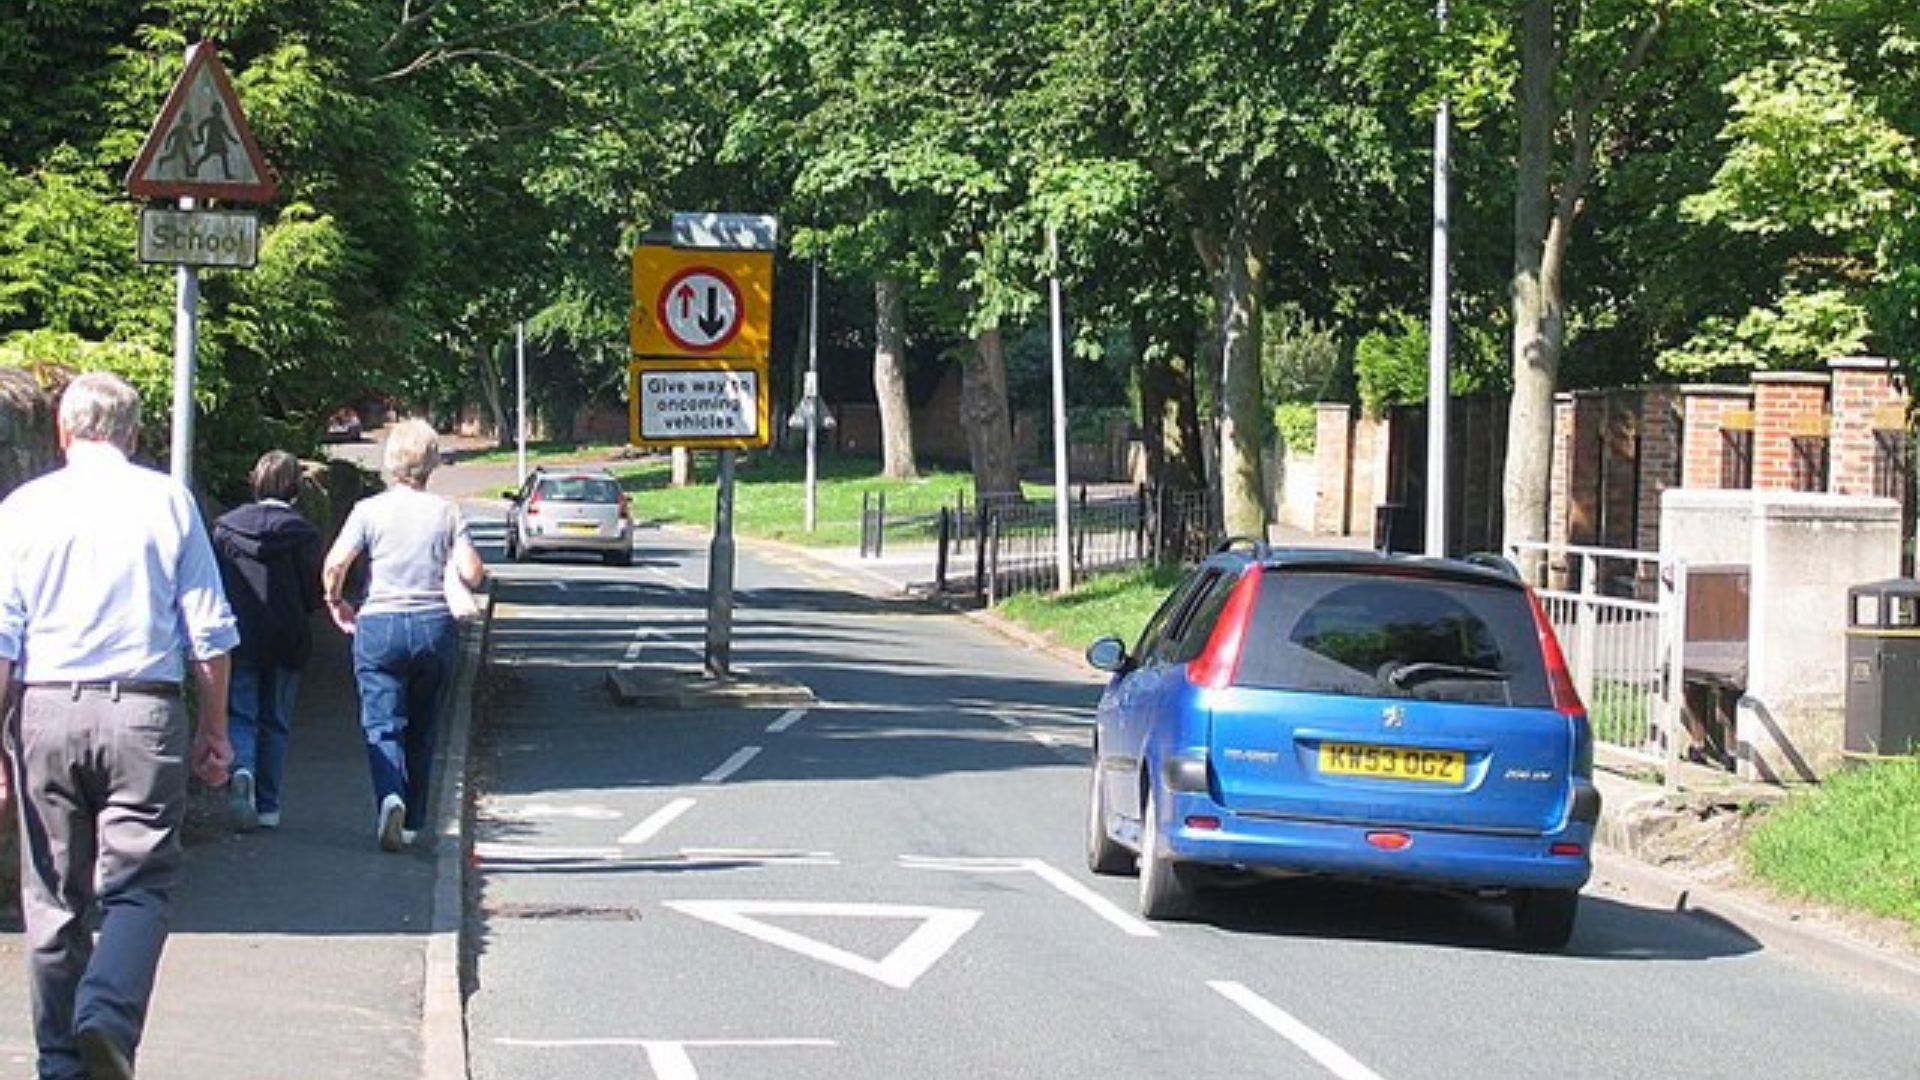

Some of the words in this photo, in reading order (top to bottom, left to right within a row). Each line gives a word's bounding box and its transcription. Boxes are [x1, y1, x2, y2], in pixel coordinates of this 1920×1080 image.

[151, 224, 246, 253] School
[648, 378, 686, 394] Give
[692, 381, 726, 396] way
[657, 396, 740, 413] oncoming
[664, 413, 735, 430] vehicles
[1331, 745, 1397, 772] KW53
[1404, 751, 1454, 778] OGZ
